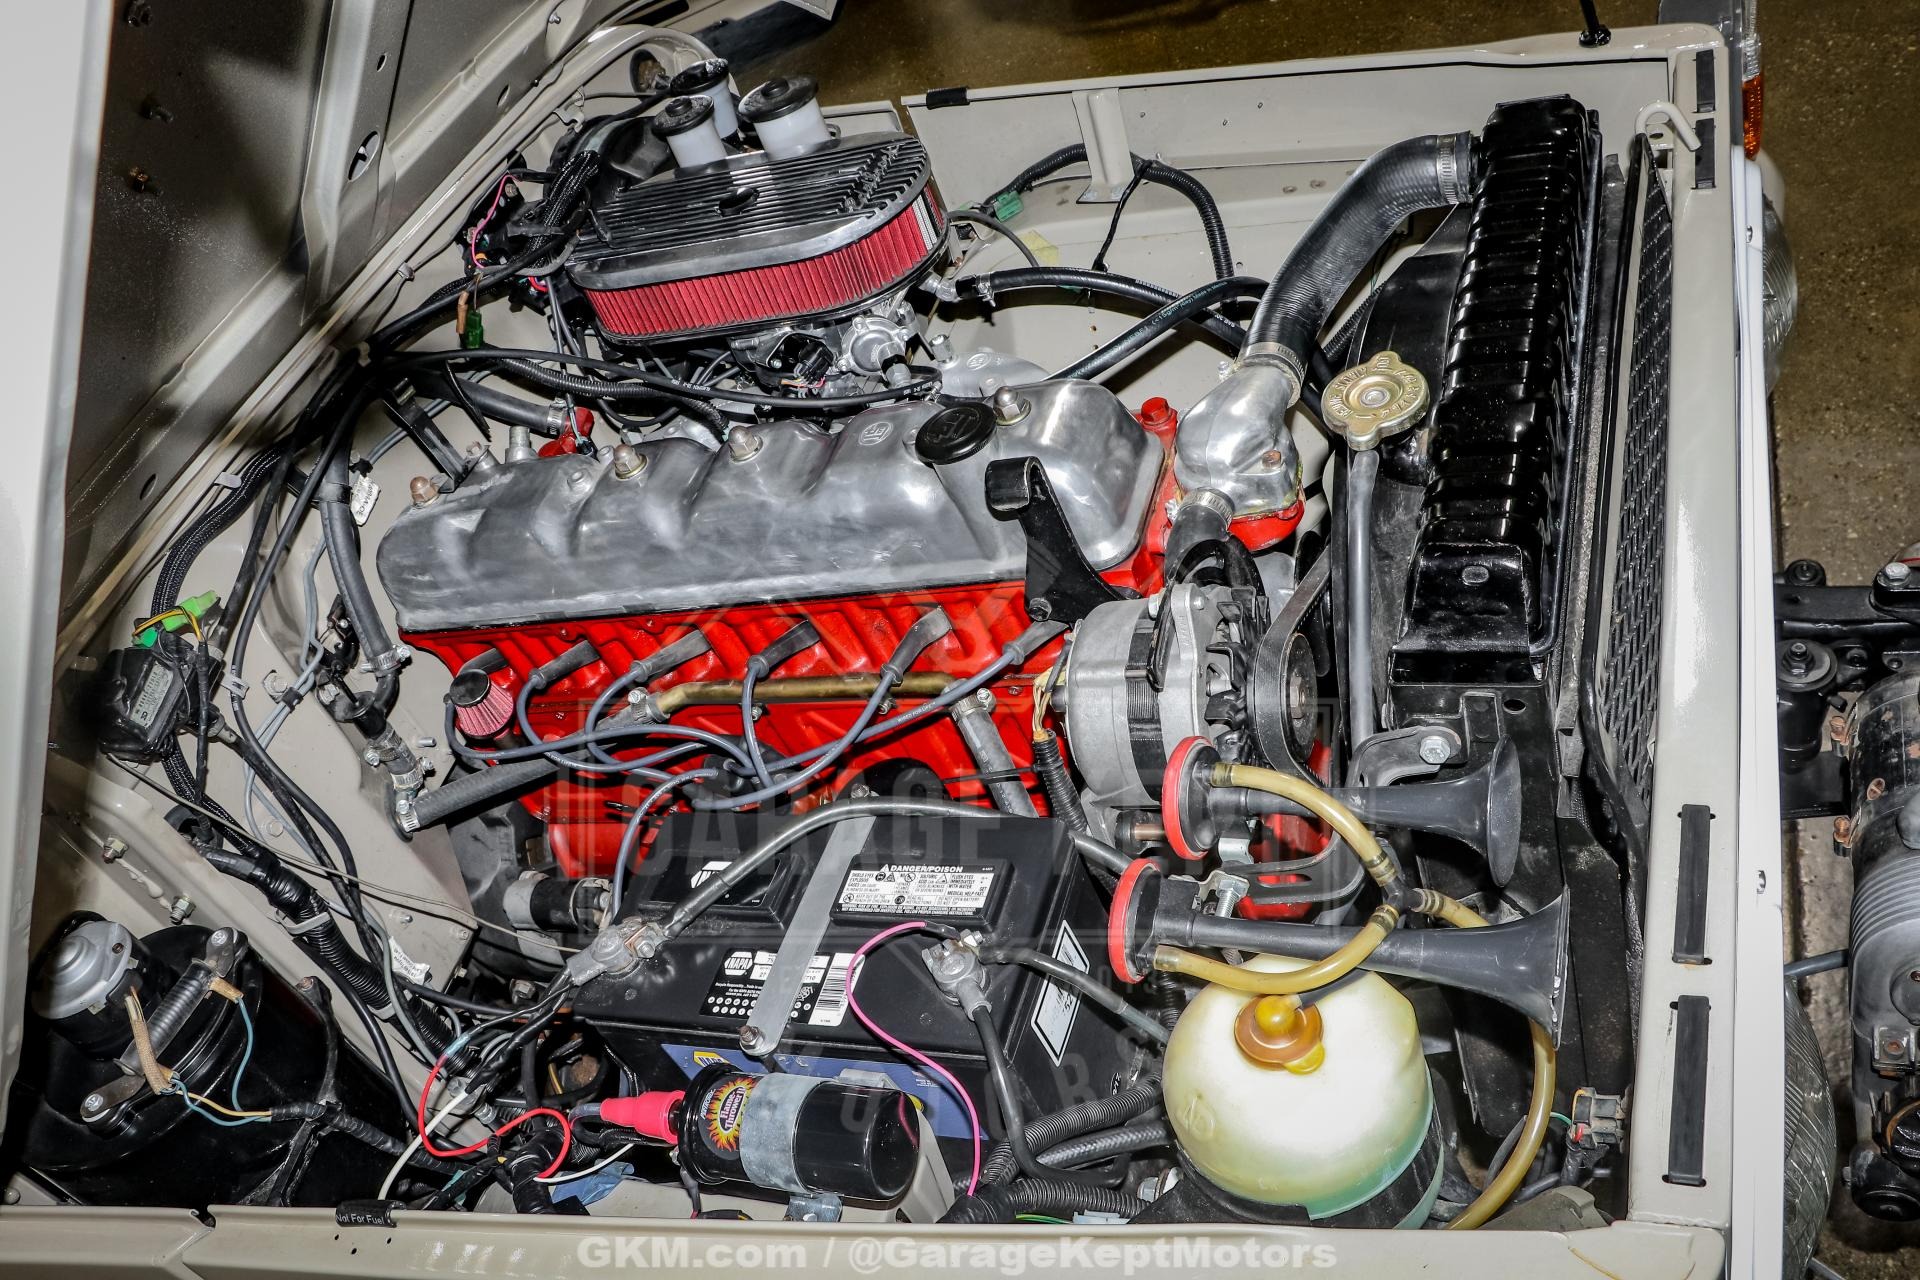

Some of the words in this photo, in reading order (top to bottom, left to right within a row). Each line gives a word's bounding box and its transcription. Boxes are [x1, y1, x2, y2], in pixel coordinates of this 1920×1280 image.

[890, 865, 963, 873] DANGER/POISON
[729, 957, 750, 970] NAPA
[350, 1213, 365, 1223] For
[366, 1214, 385, 1225] Fuel
